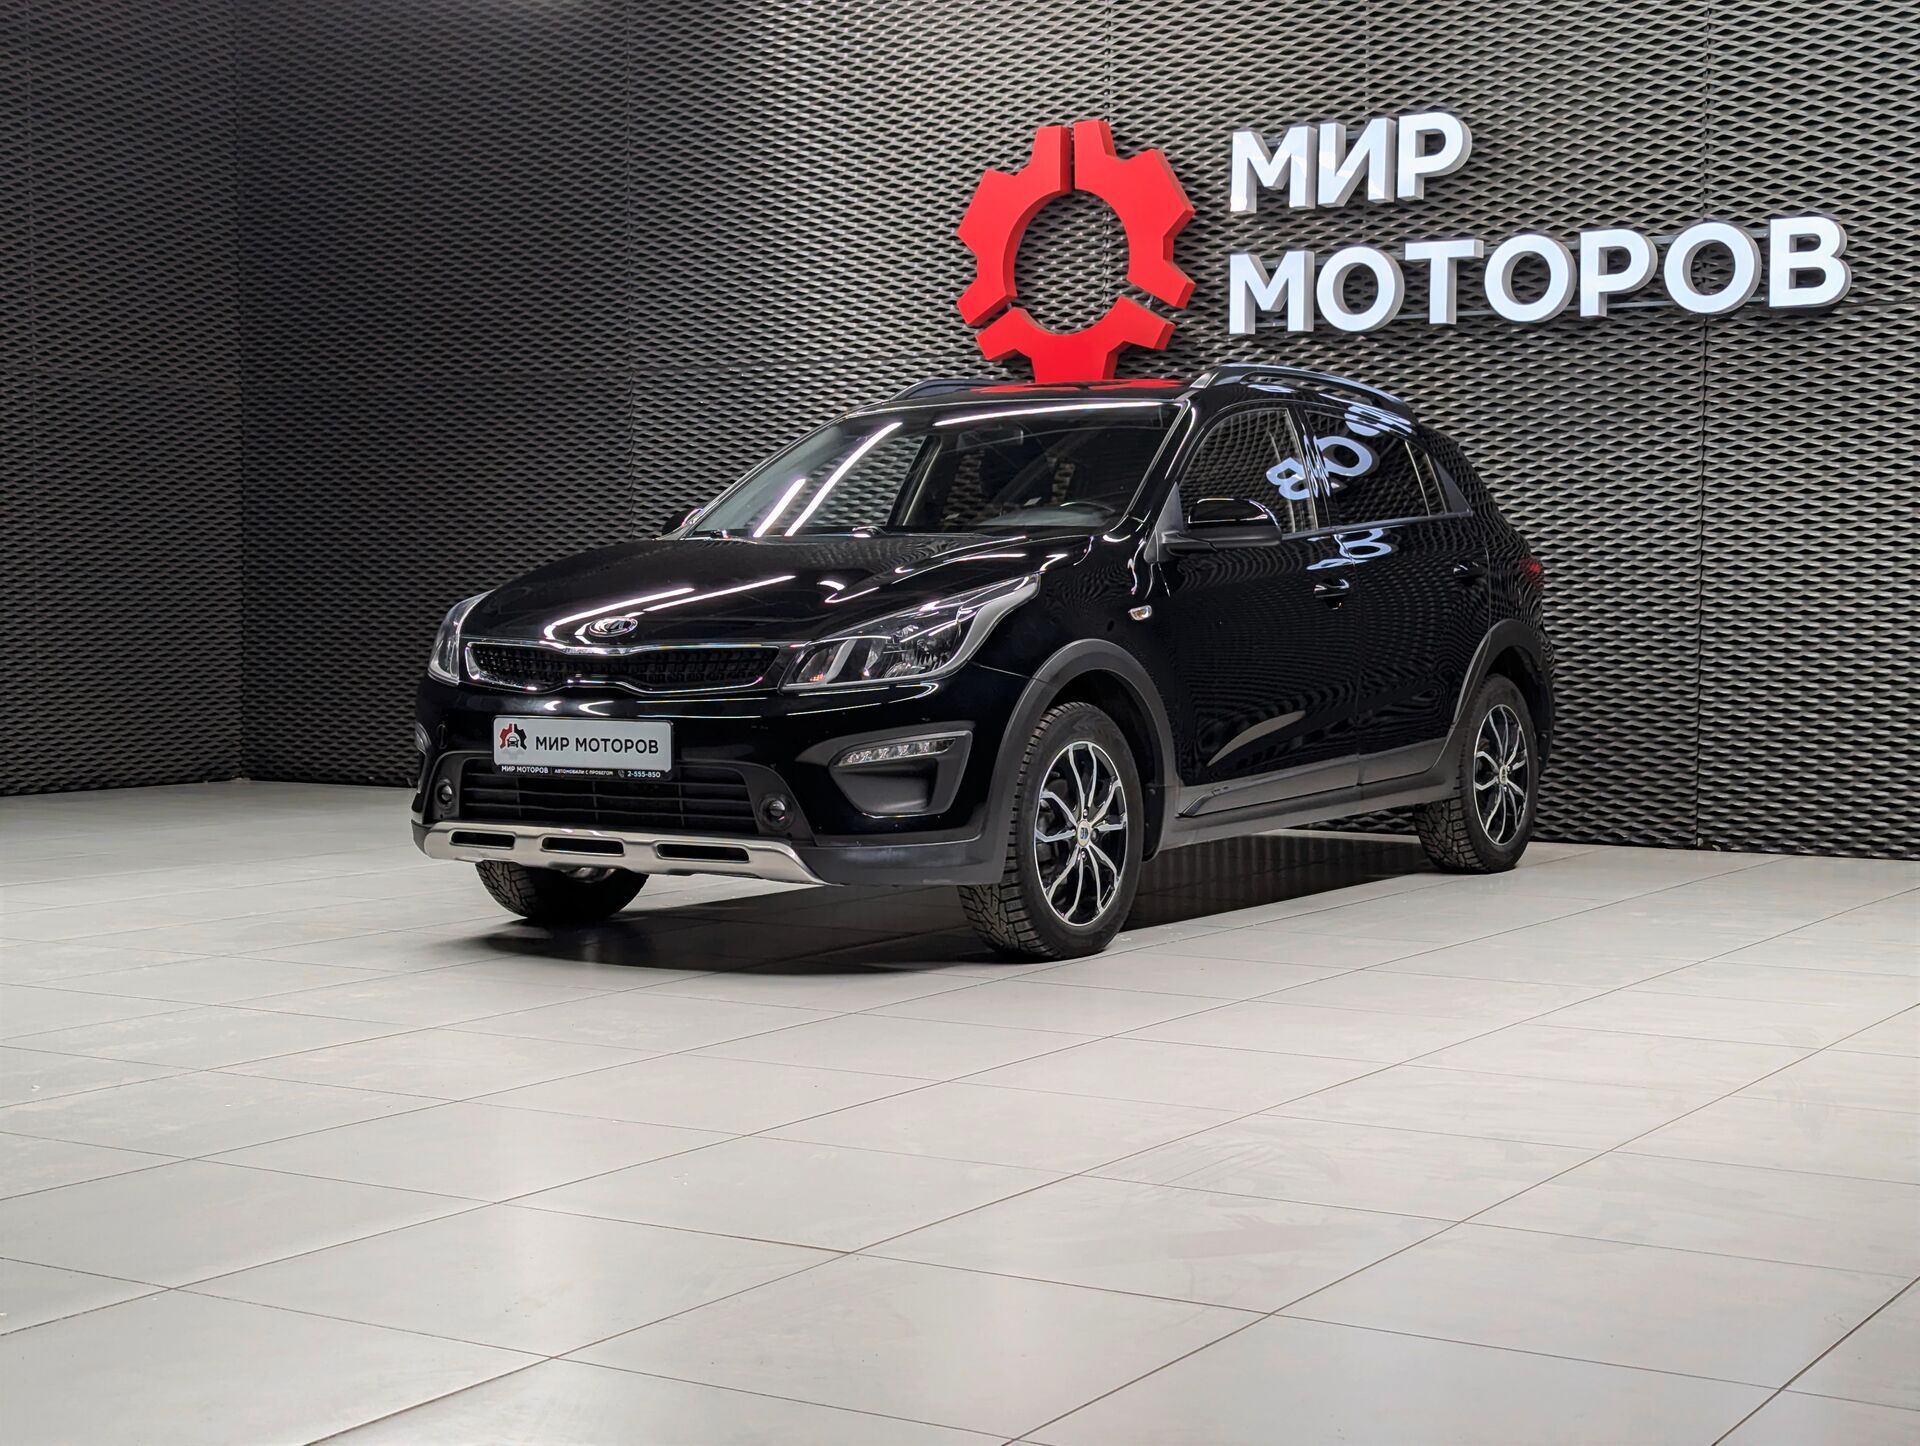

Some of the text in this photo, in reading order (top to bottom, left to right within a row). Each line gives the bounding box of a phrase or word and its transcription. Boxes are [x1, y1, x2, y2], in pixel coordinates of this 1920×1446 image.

[1229, 112, 1473, 214] МИР
[1228, 216, 1852, 335] МОТОРОВ
[535, 736, 659, 754] МИР МОТОРОВ
[516, 766, 549, 774] МОТОРОВ
[627, 770, 661, 778] 2-555-850
